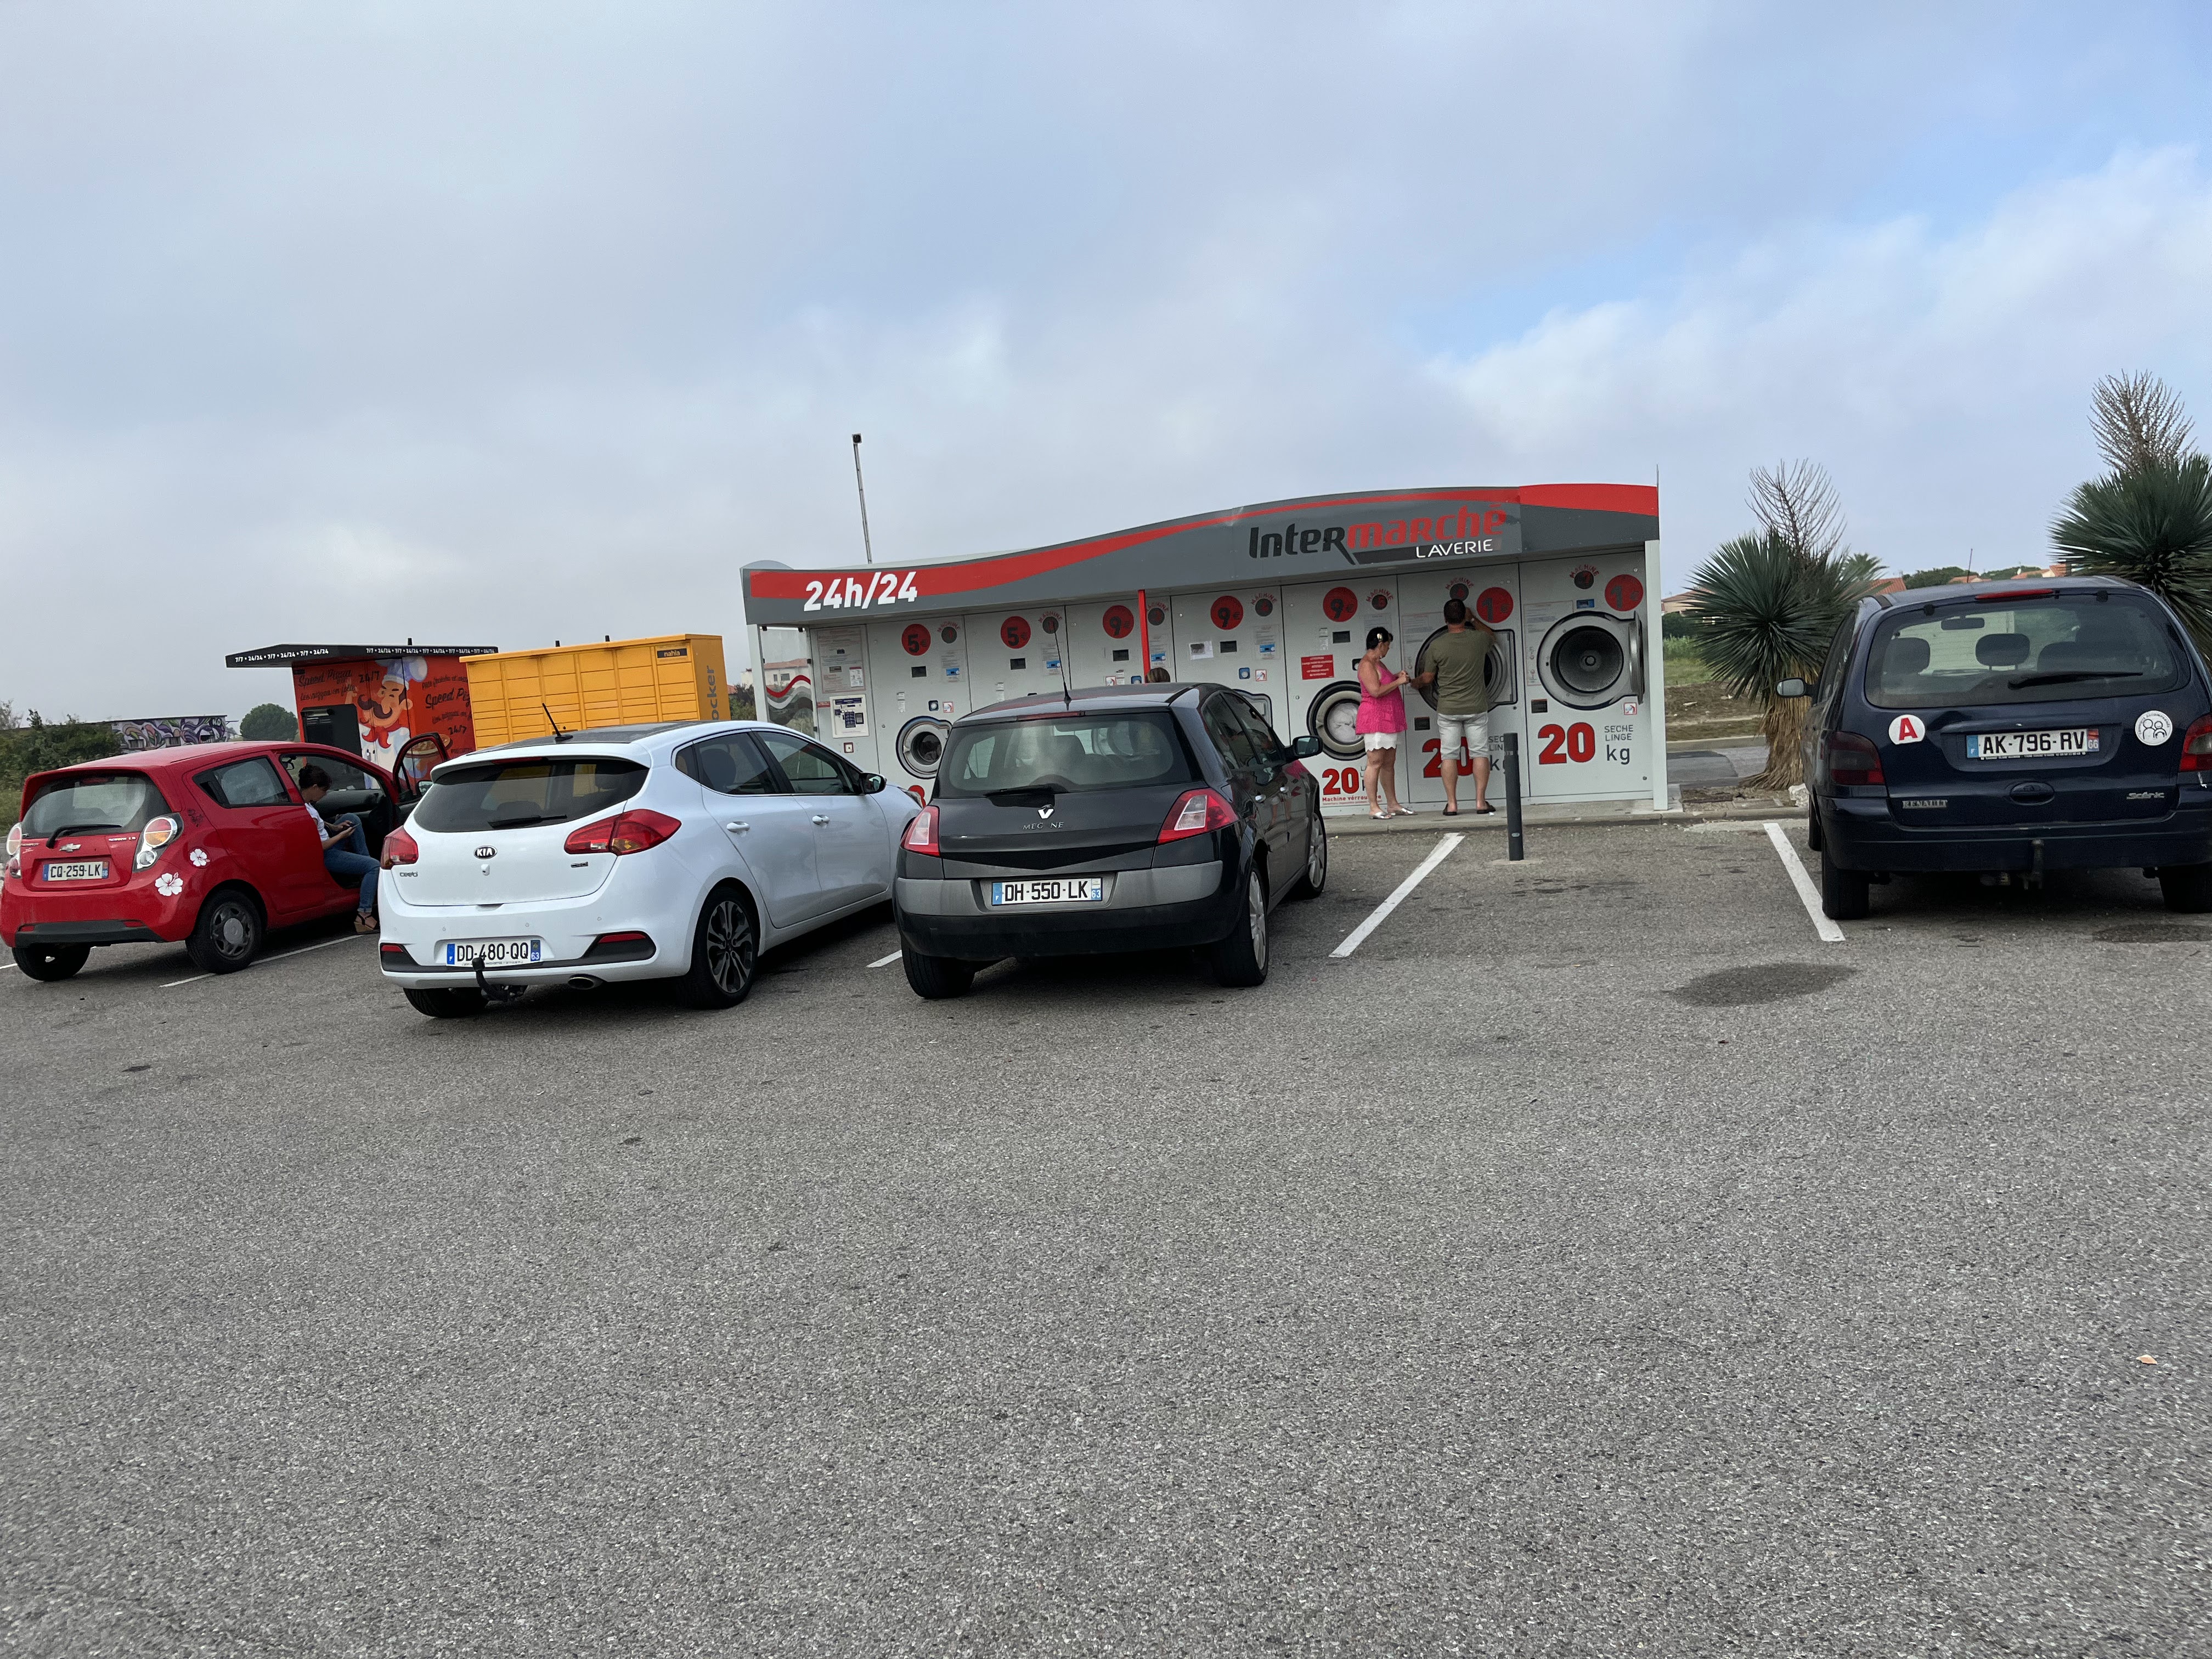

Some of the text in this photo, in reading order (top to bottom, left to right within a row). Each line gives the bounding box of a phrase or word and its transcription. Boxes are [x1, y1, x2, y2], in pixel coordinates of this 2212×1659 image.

[1415, 539, 1493, 558] LAVERIE
[1570, 564, 1600, 579] MACHINE
[804, 571, 918, 612] 24h/24
[1147, 601, 1169, 613] ACHINE
[358, 671, 380, 683] 24/7
[425, 687, 455, 710] Speed
[1605, 733, 1632, 741] LINGE
[1899, 718, 1918, 741] A
[1538, 722, 1596, 765] 20
[1983, 731, 2084, 754] AK-796-RV
[2088, 739, 2098, 749] 66
[1606, 744, 1630, 765] kg
[1322, 767, 1359, 795] 20
[477, 848, 493, 856] KIA
[50, 864, 101, 878] CQ-259-LK
[1005, 881, 1088, 901] DH-550-LK
[1092, 889, 1101, 899] 63
[457, 943, 528, 962] DD-480-QQ
[531, 952, 540, 961] 63
